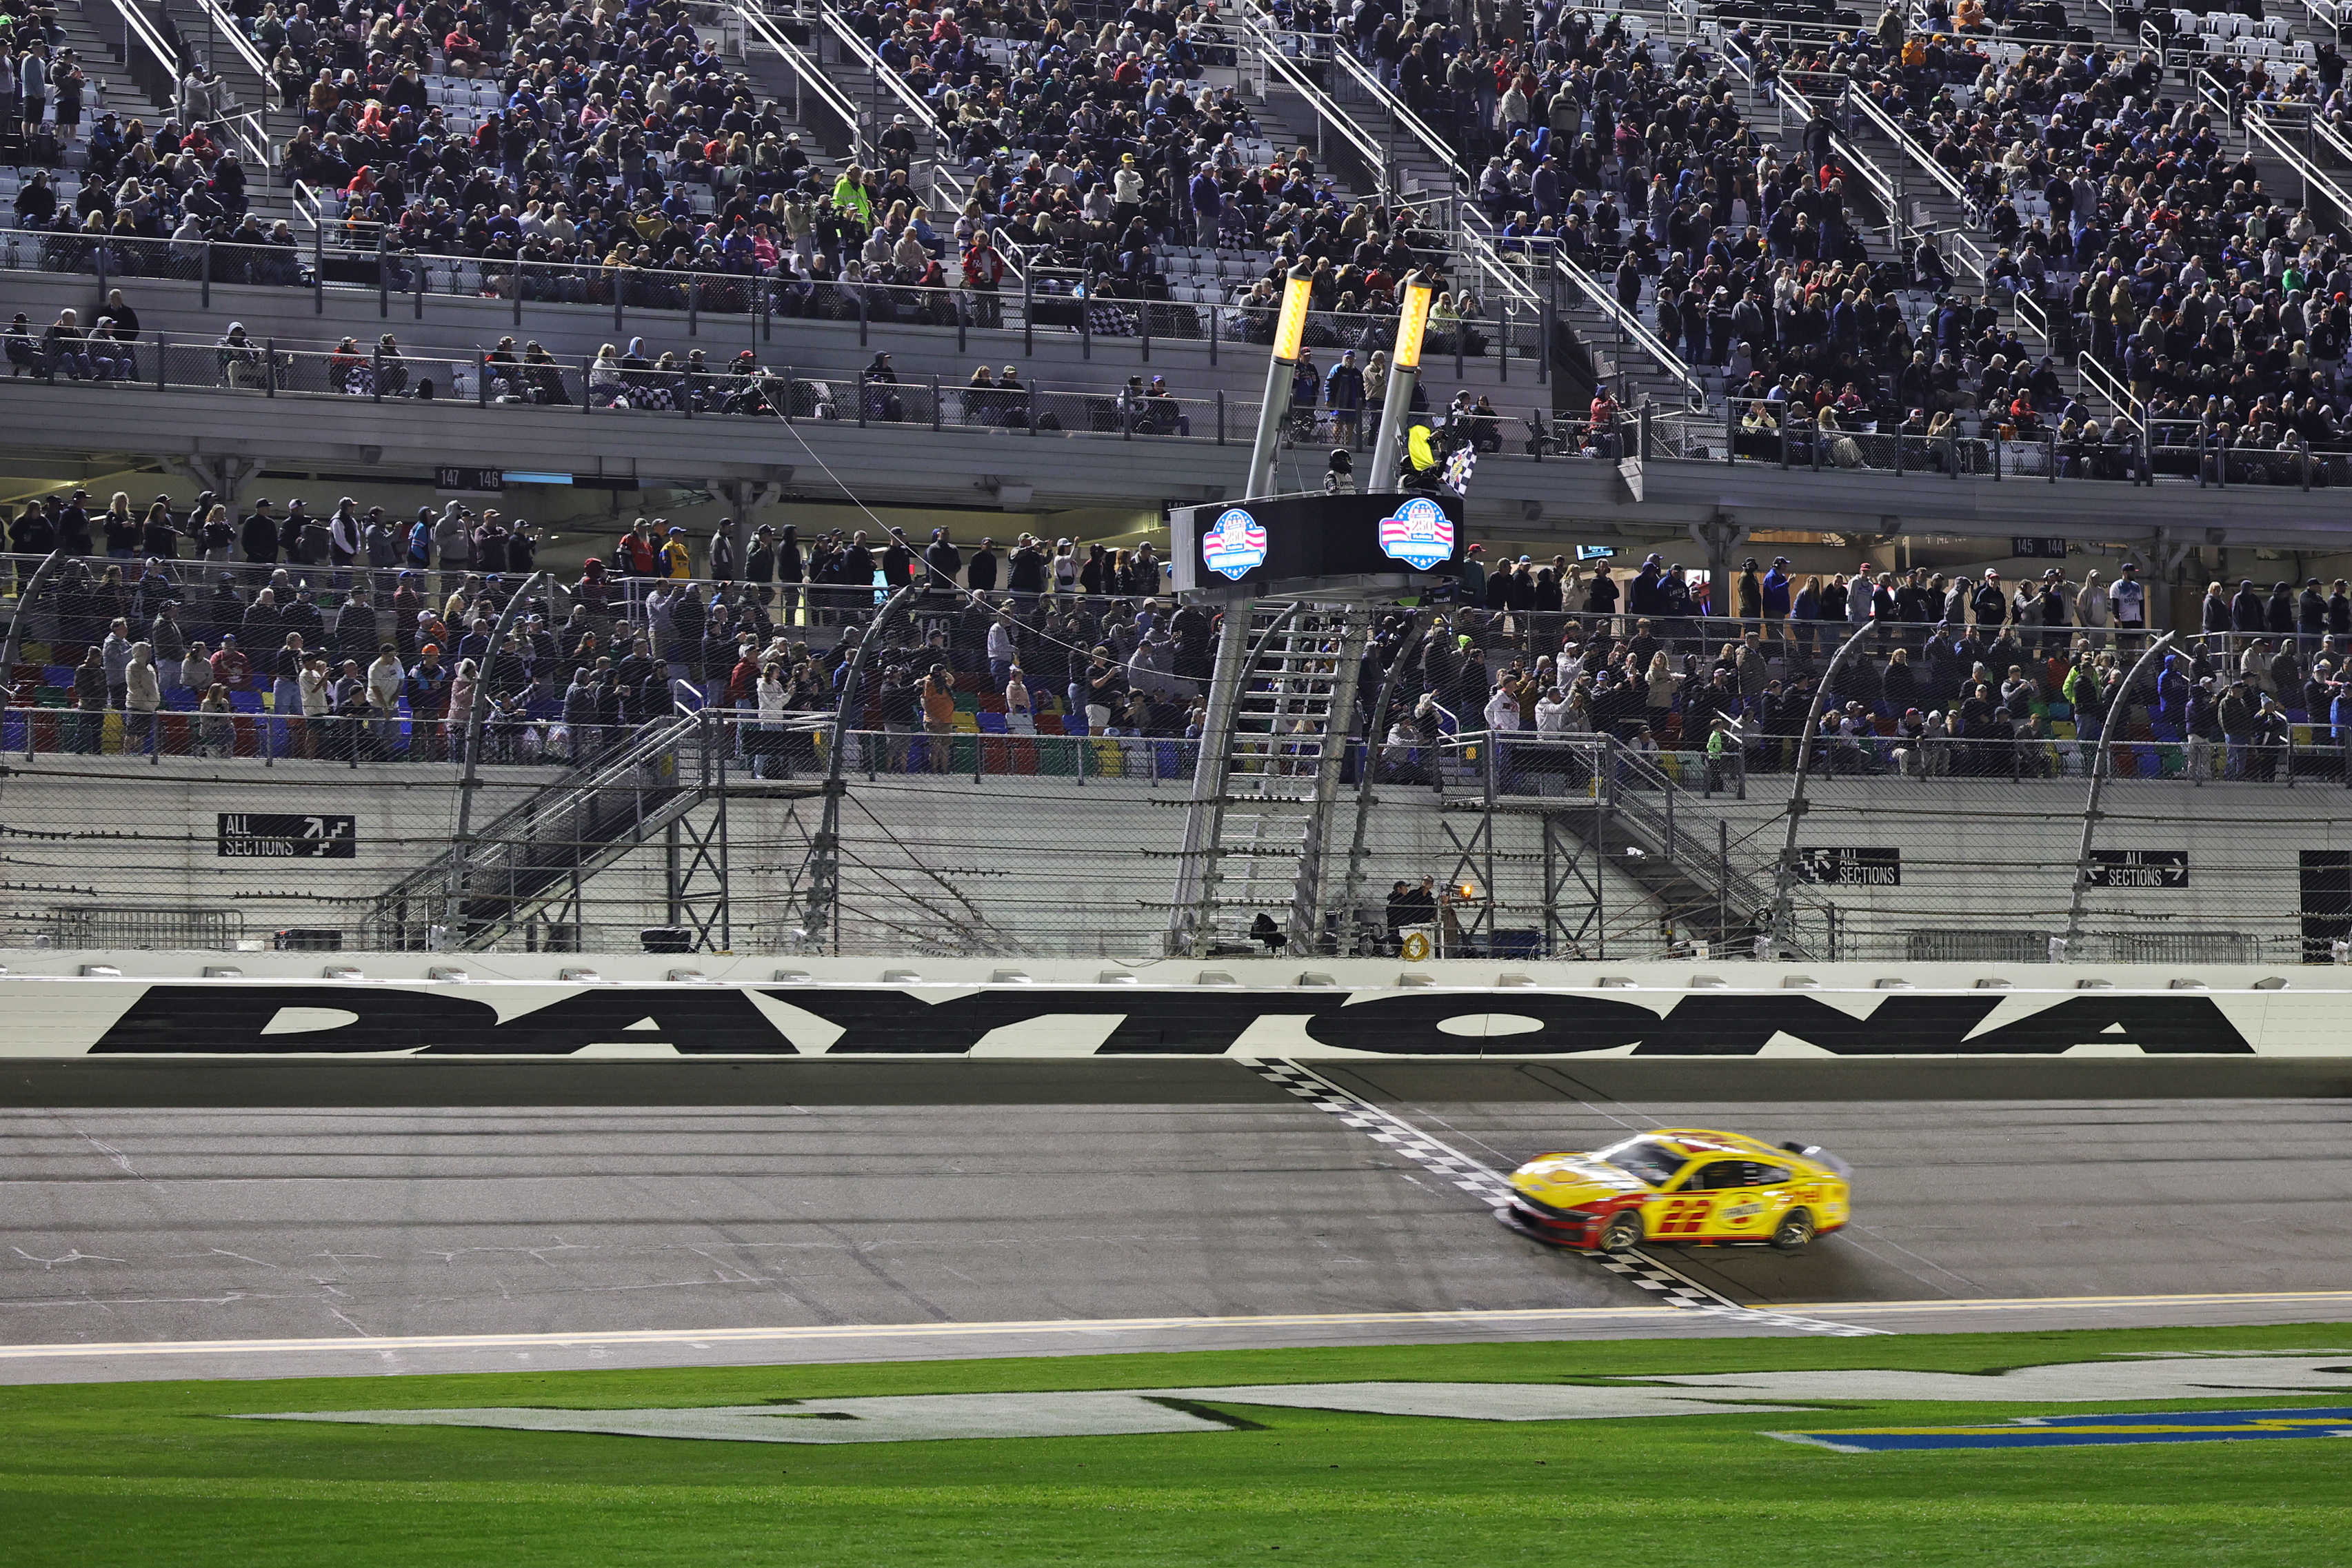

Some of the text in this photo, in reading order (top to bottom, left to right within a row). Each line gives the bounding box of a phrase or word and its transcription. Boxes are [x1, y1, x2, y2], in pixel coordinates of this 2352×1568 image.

[441, 469, 499, 488] 147 146
[1411, 519, 1433, 532] 250
[1226, 530, 1244, 543] 250
[2017, 539, 2063, 554] 145 144
[225, 814, 251, 834] ALL
[225, 835, 294, 856] SECTIONS
[1840, 848, 1860, 865] ALL
[2126, 851, 2142, 867] ALL
[1839, 866, 1895, 885] SECTIONS
[2109, 868, 2162, 887] SECTIONS
[87, 985, 2256, 1056] DAYTONA
